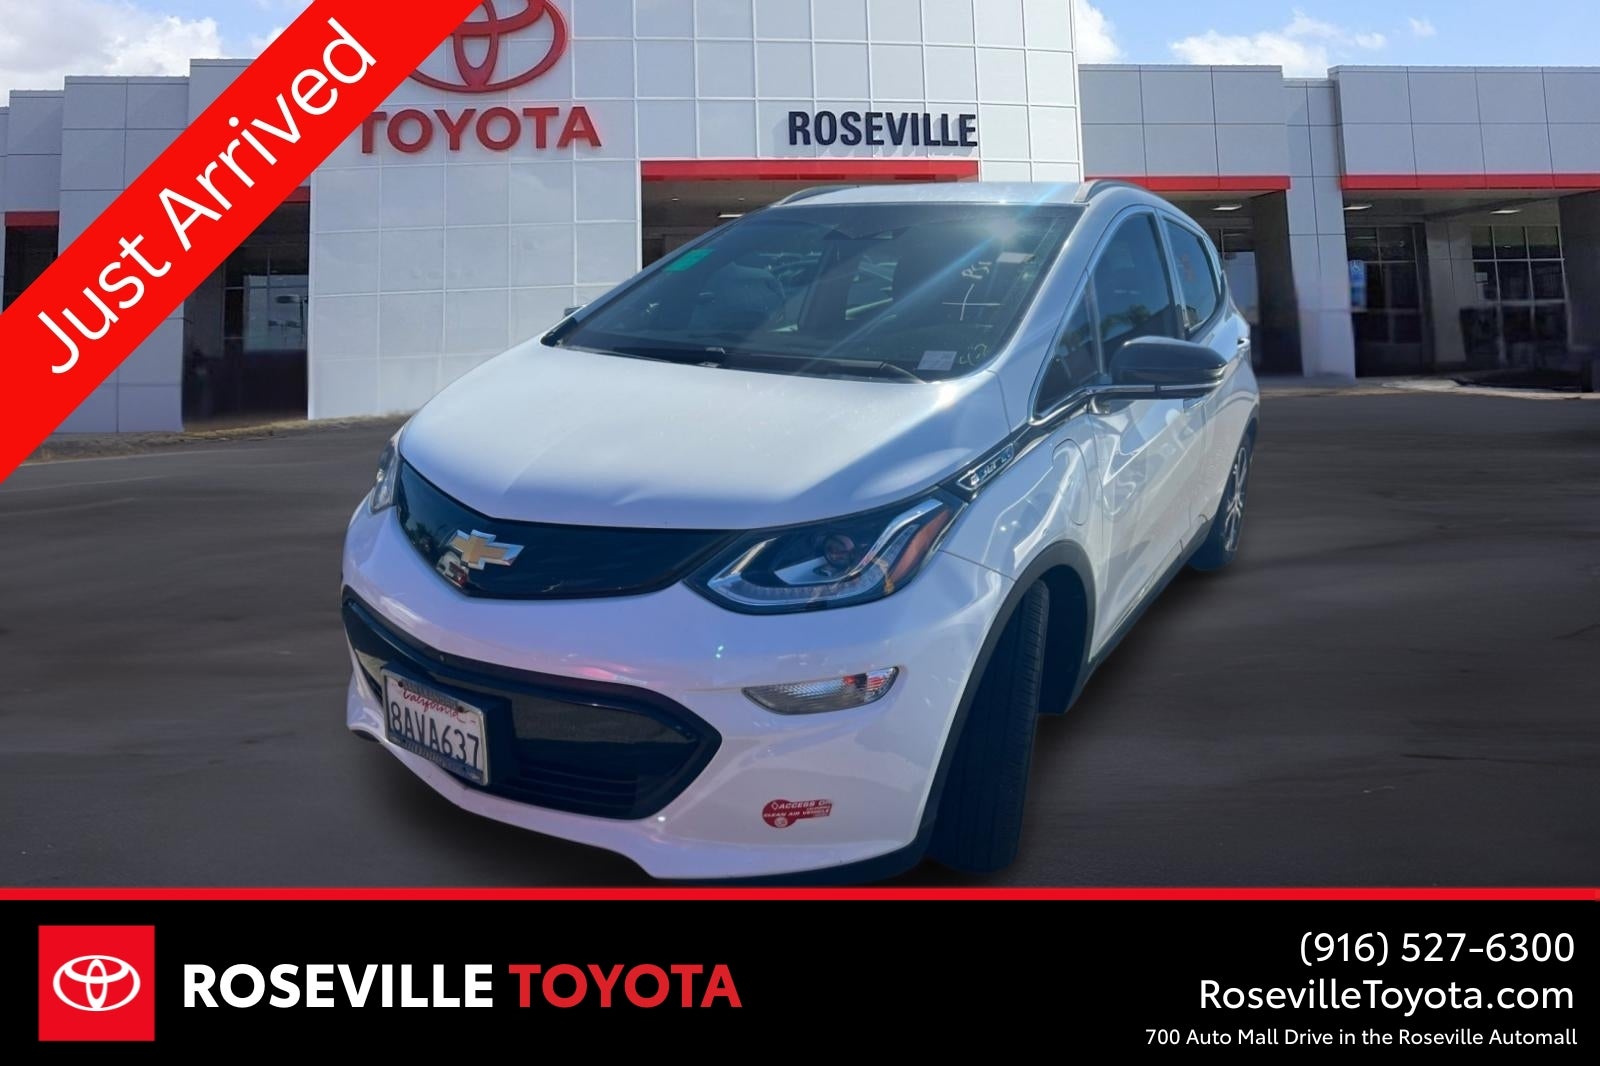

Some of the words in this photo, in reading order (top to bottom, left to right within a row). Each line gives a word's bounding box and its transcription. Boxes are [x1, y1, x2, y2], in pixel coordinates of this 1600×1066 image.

[361, 106, 602, 153] TOYOTA
[788, 111, 977, 147] ROSEVILLE
[391, 701, 480, 769] 8AVA637
